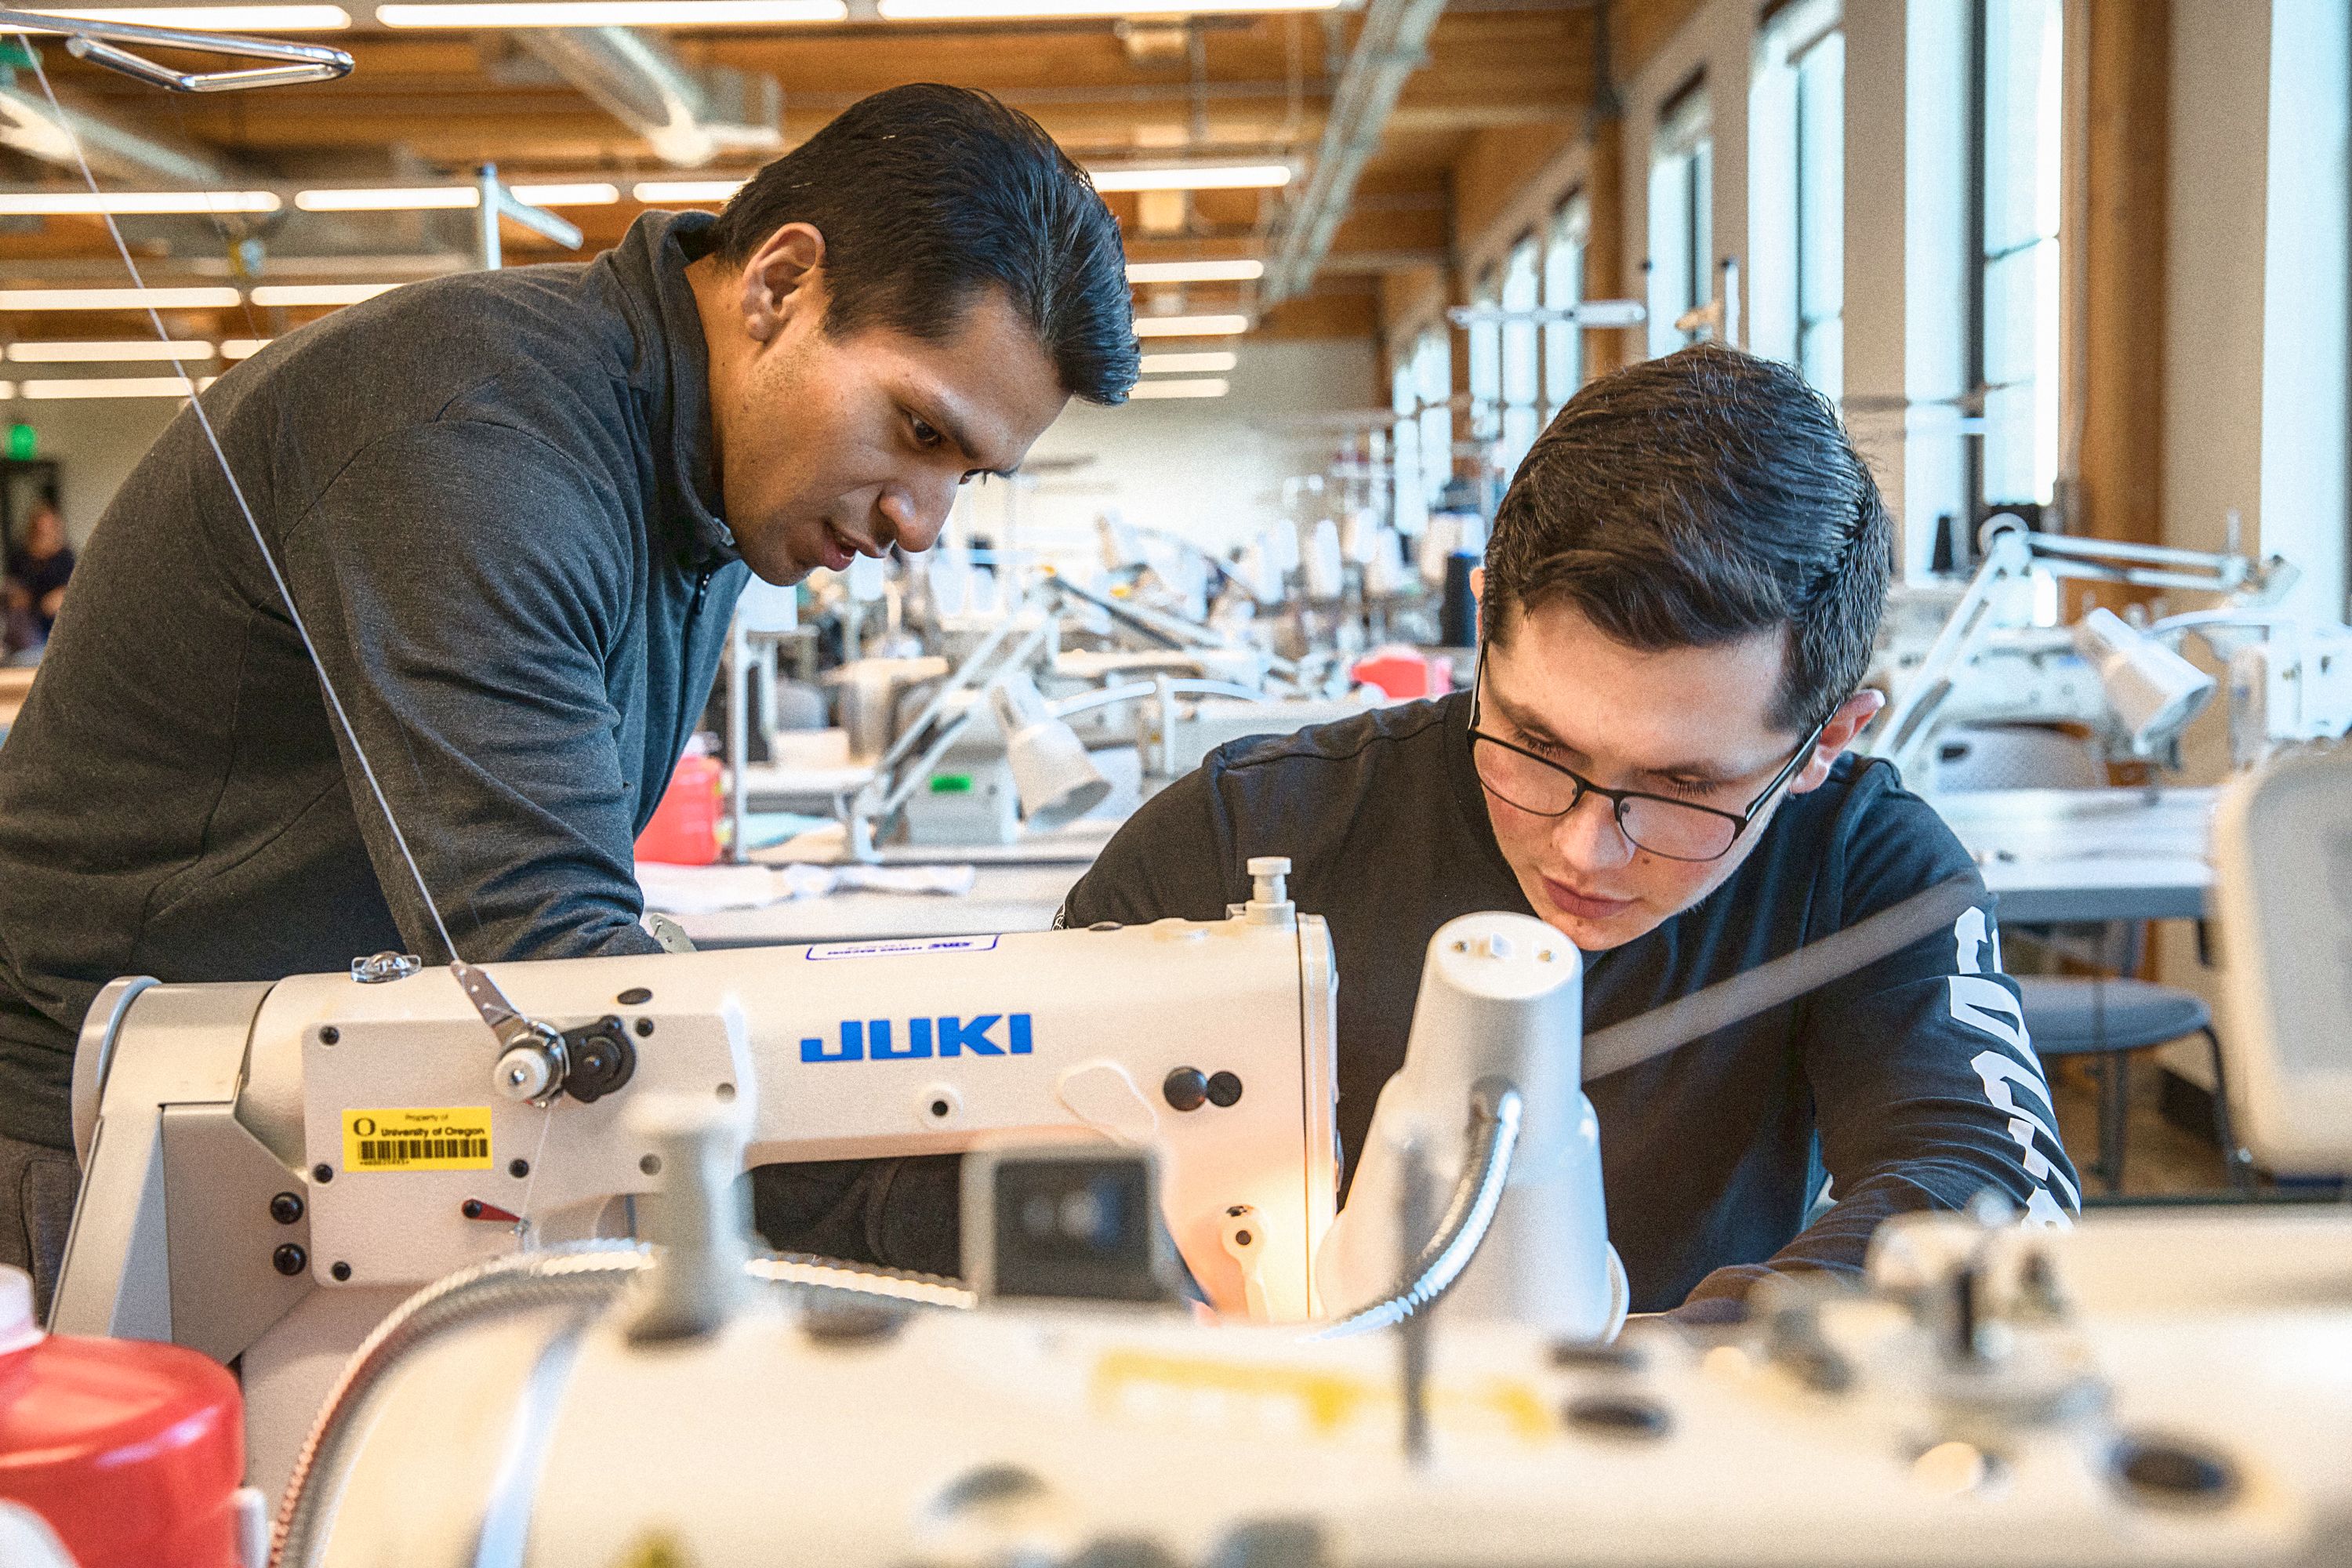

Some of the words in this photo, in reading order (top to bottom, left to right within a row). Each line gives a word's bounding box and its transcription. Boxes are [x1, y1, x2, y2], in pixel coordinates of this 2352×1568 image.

[800, 1013, 1033, 1063] JUKI
[353, 1118, 376, 1136] O
[381, 1127, 429, 1138] University
[432, 1127, 442, 1136] of
[445, 1127, 485, 1138] Oregon
